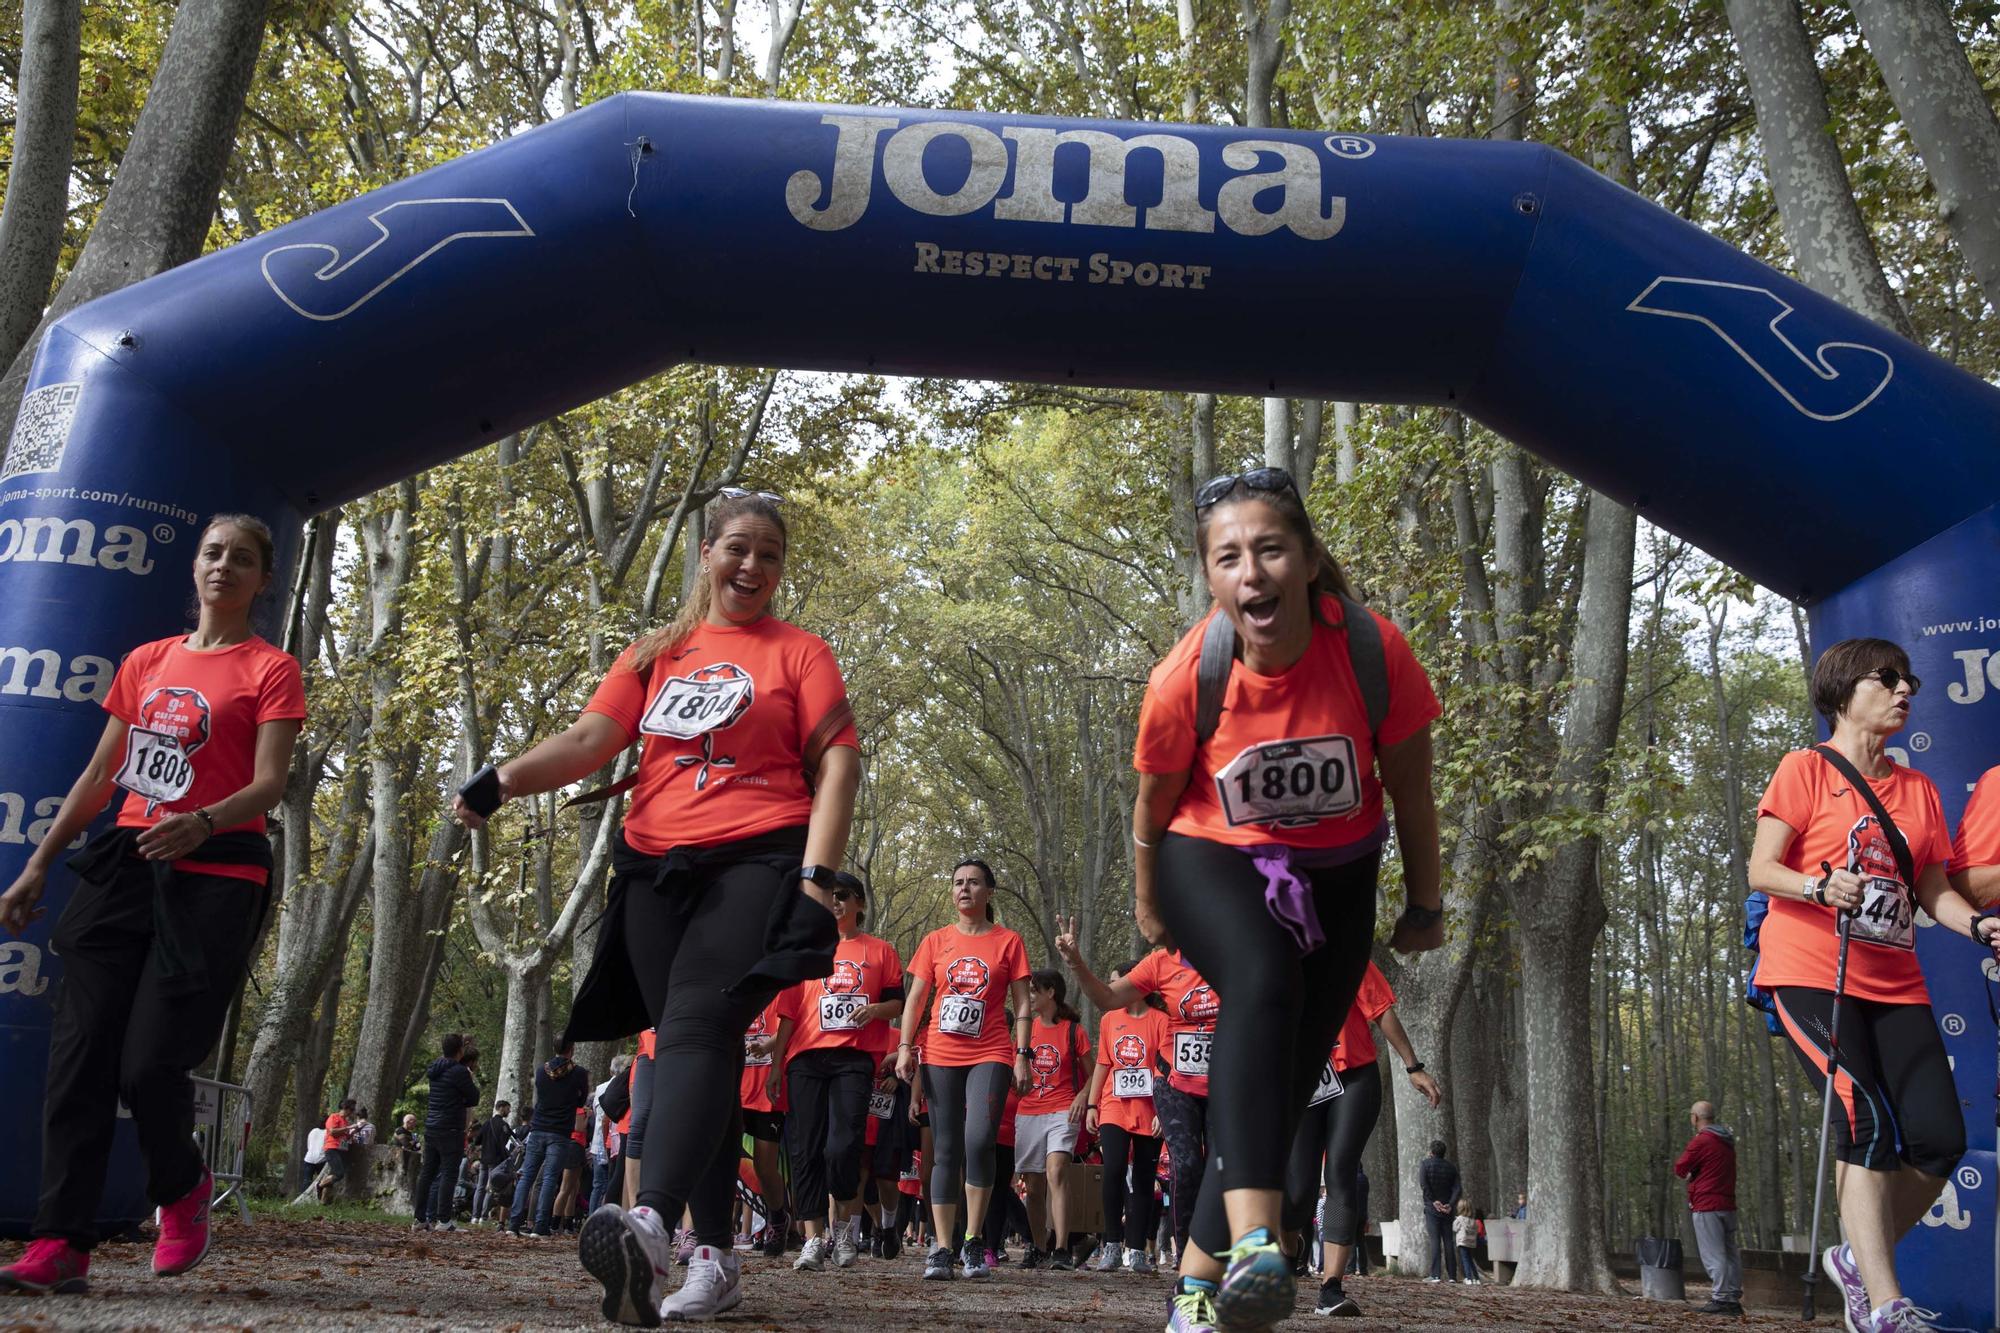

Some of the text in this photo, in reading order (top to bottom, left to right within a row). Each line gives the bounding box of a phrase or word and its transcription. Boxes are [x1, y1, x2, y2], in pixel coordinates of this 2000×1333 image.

[1922, 616, 2000, 636] www.jo
[662, 691, 739, 721] 1804
[135, 746, 191, 788] 1808
[1234, 757, 1345, 803] 1800
[823, 1003, 865, 1020] 369
[942, 1004, 981, 1025] 2509
[1120, 1074, 1146, 1089] 396
